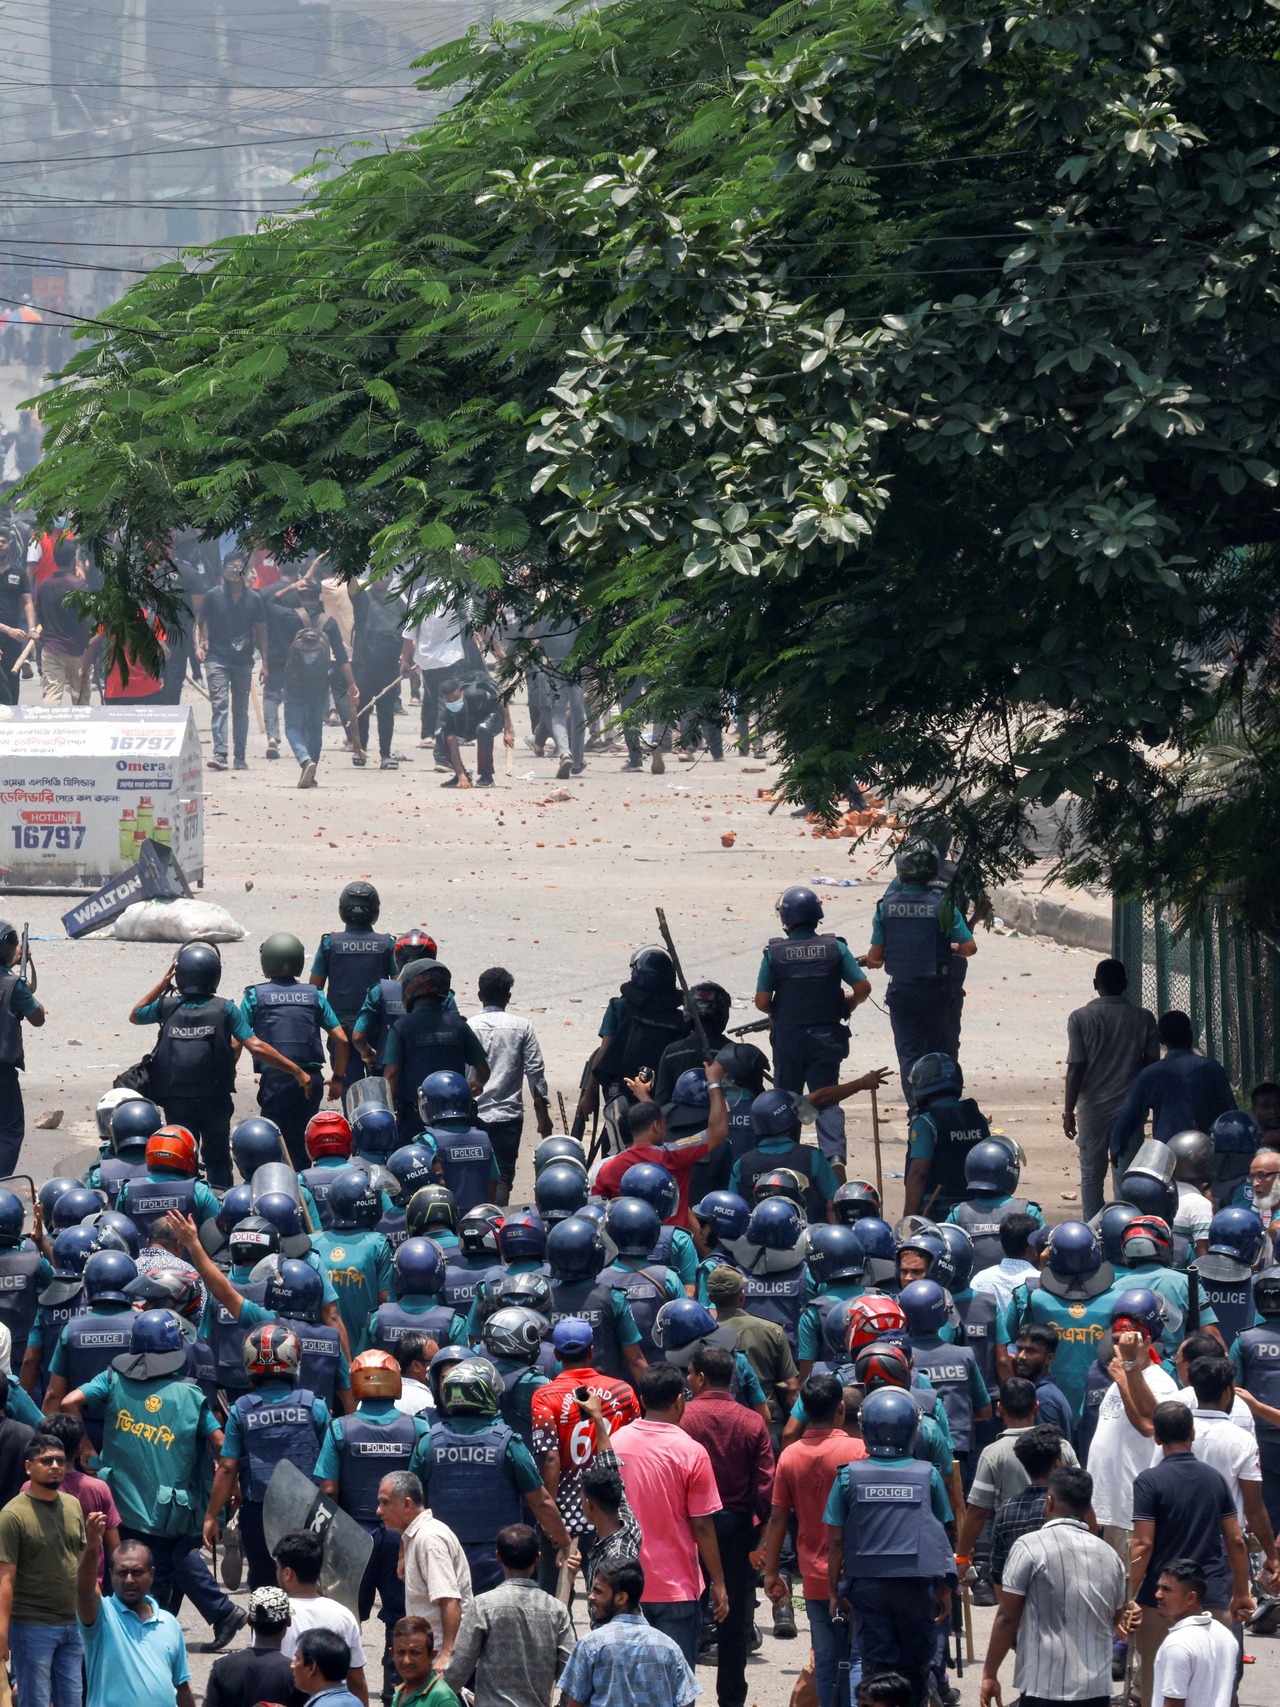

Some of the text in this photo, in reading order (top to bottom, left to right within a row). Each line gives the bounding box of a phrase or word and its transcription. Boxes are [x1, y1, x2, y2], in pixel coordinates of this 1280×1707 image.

[110, 736, 177, 750] 16797
[116, 760, 166, 771] Omera
[0, 788, 55, 804] ডেলিভারি
[11, 825, 86, 850] 16797
[73, 874, 142, 924] WALTON
[888, 904, 935, 917] POLICE
[342, 941, 379, 952] POLICE
[789, 946, 823, 959] POLICE
[270, 992, 310, 1004] POLICE
[172, 1025, 214, 1038] POLICE
[729, 1115, 750, 1126] ICE
[950, 1129, 983, 1142] POLICE
[453, 1148, 481, 1158] POLICE
[406, 1168, 429, 1181] POLICE
[141, 1199, 175, 1210] POLICE
[356, 1198, 377, 1208] POLICE
[714, 1205, 736, 1217] POLICE
[231, 1232, 262, 1243] POLICE
[809, 1252, 825, 1262] POLICE
[937, 1259, 954, 1272] POLICE
[327, 1265, 366, 1289] মপি
[271, 1286, 293, 1297] POLICE
[453, 1287, 476, 1300] POL
[748, 1281, 791, 1294] POLICE
[52, 1306, 94, 1321] POLICE
[84, 1334, 119, 1344] POLICE
[302, 1341, 331, 1352] POLICE
[925, 1365, 966, 1380] OLICE
[560, 1389, 577, 1424] INDIR
[587, 1386, 612, 1401] OAD
[247, 1408, 308, 1427] POLICE
[115, 1408, 175, 1450] ডিএমপি
[366, 1444, 396, 1452] POLICE
[436, 1447, 496, 1463] POLICE
[869, 1488, 908, 1498] POLICE
